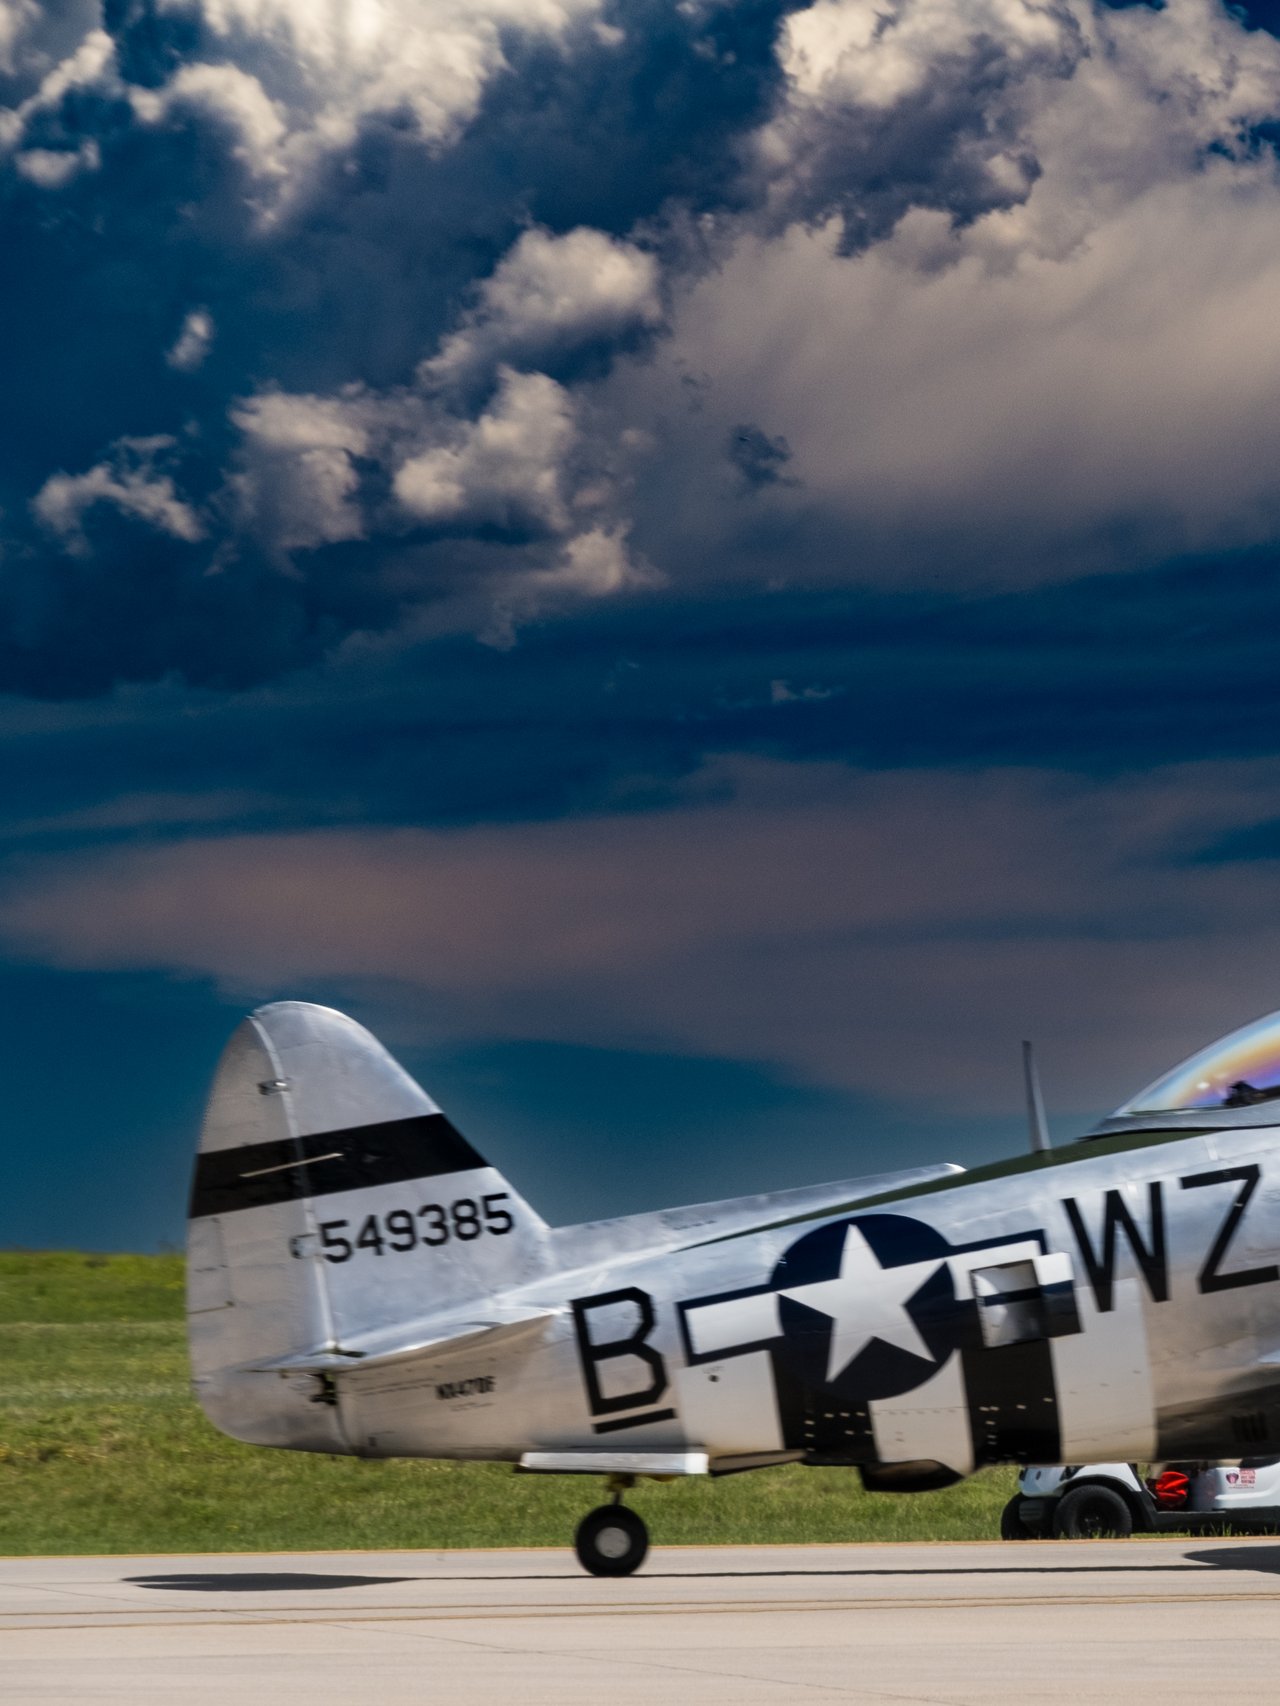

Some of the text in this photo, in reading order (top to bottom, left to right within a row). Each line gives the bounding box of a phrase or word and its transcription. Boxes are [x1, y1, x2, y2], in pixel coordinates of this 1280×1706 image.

[319, 1193, 514, 1263] 549385
[1061, 1163, 1280, 1312] WZ
[571, 1286, 669, 1416] B
